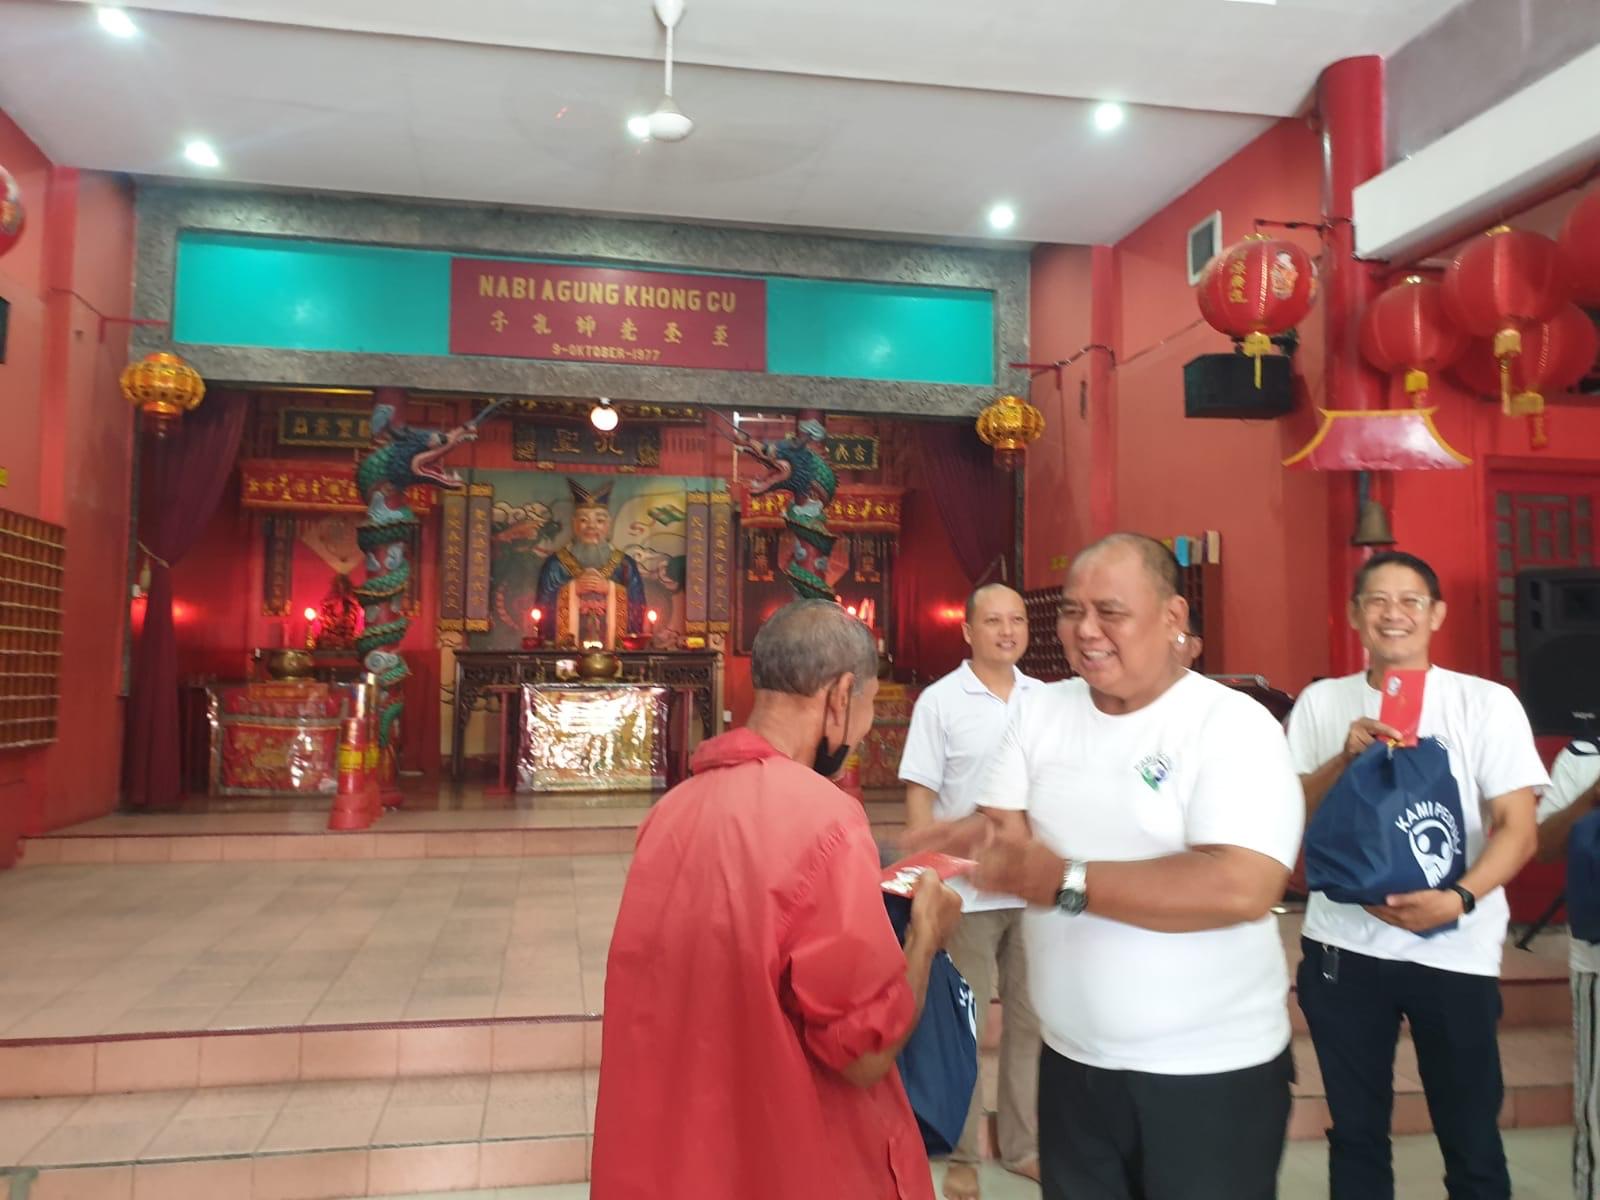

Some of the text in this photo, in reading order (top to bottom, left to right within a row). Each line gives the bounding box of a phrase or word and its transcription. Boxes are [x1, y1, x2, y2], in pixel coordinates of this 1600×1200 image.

[480, 275, 737, 313] NABI AGUNG KHONG CU
[1395, 800, 1434, 834] KAMI
